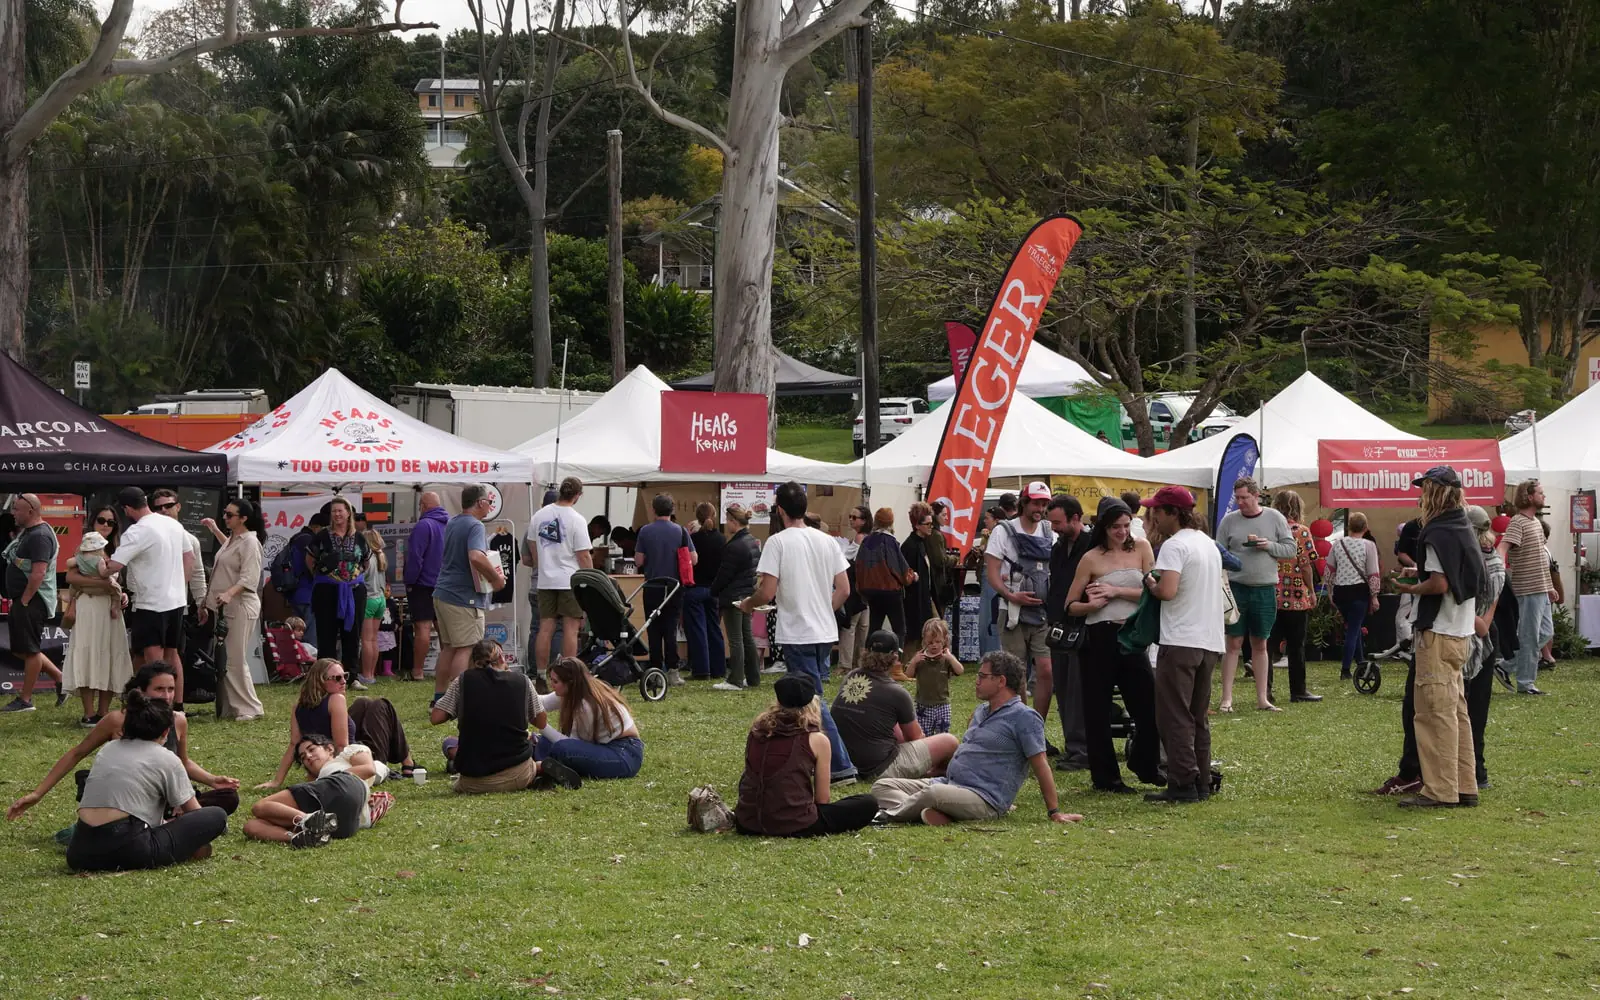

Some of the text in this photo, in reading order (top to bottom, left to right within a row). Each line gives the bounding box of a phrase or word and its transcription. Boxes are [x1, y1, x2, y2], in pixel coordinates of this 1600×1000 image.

[1028, 245, 1056, 276] TRAEGER
[76, 363, 88, 371] ONE
[319, 408, 392, 429] HEAPS
[13, 436, 66, 448] BAY
[327, 438, 404, 453] NORMAL
[696, 437, 737, 453] KOREAN
[1397, 449, 1418, 458] GYOZA
[290, 458, 489, 473] TOO GOOD TO BE WASTED
[1331, 469, 1411, 492] Dumpling
